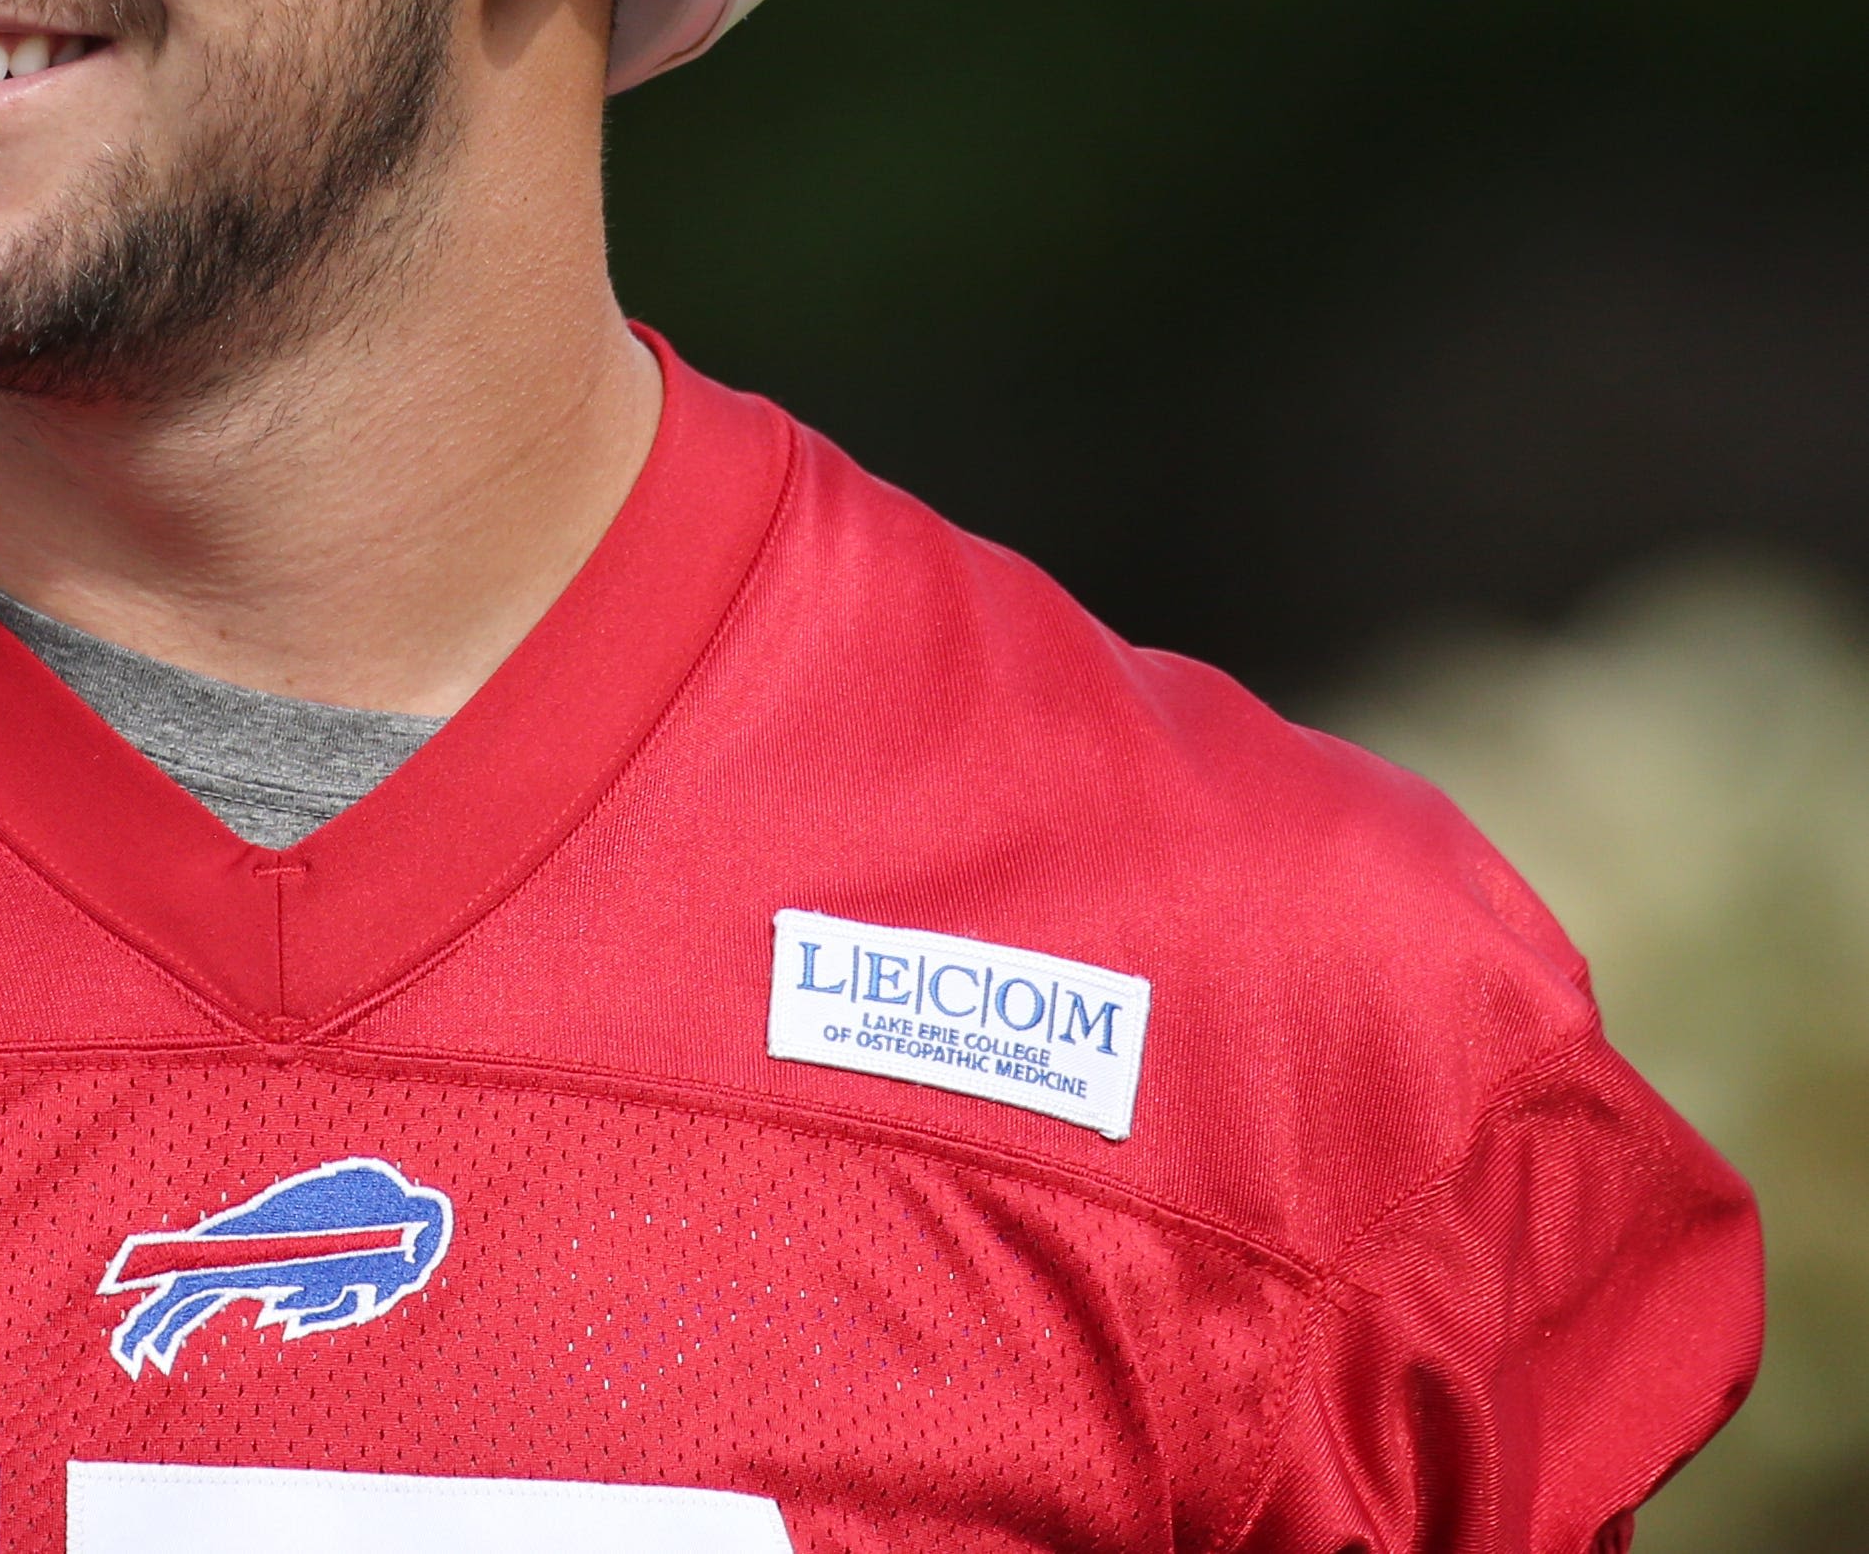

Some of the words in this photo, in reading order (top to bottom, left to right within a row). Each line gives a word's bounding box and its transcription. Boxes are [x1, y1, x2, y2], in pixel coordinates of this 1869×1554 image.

[823, 1025, 852, 1043] OF
[856, 1029, 990, 1074] OSTEOPATHIC
[994, 1061, 1088, 1099] MEDICINE
[862, 1012, 914, 1037] LAKE
[917, 1023, 960, 1047] ERIE
[964, 1031, 1051, 1068] COLLEGE
